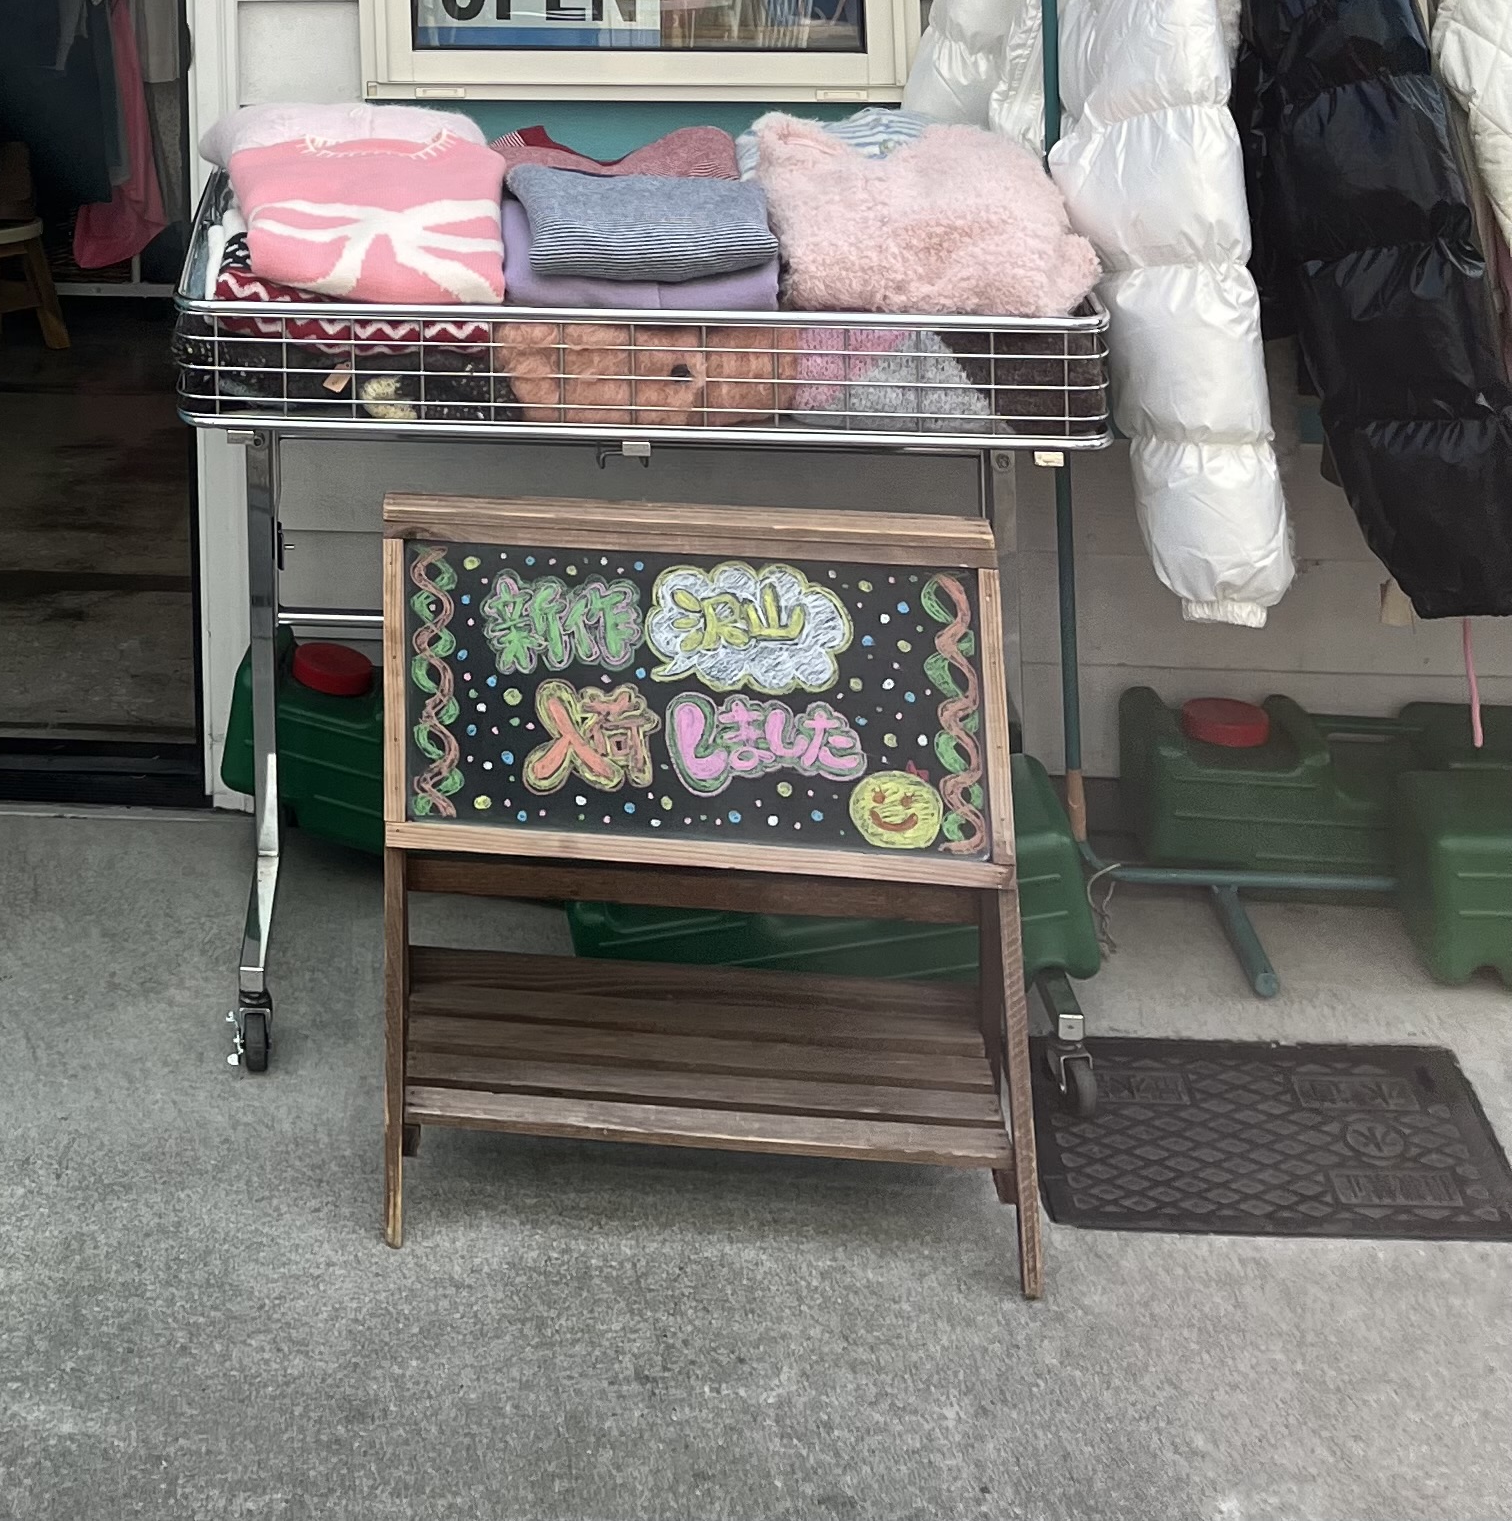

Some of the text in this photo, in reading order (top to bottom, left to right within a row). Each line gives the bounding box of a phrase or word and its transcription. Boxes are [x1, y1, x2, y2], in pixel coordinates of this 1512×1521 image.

[484, 570, 644, 675] 新作
[523, 679, 868, 797] 入荷 しました
